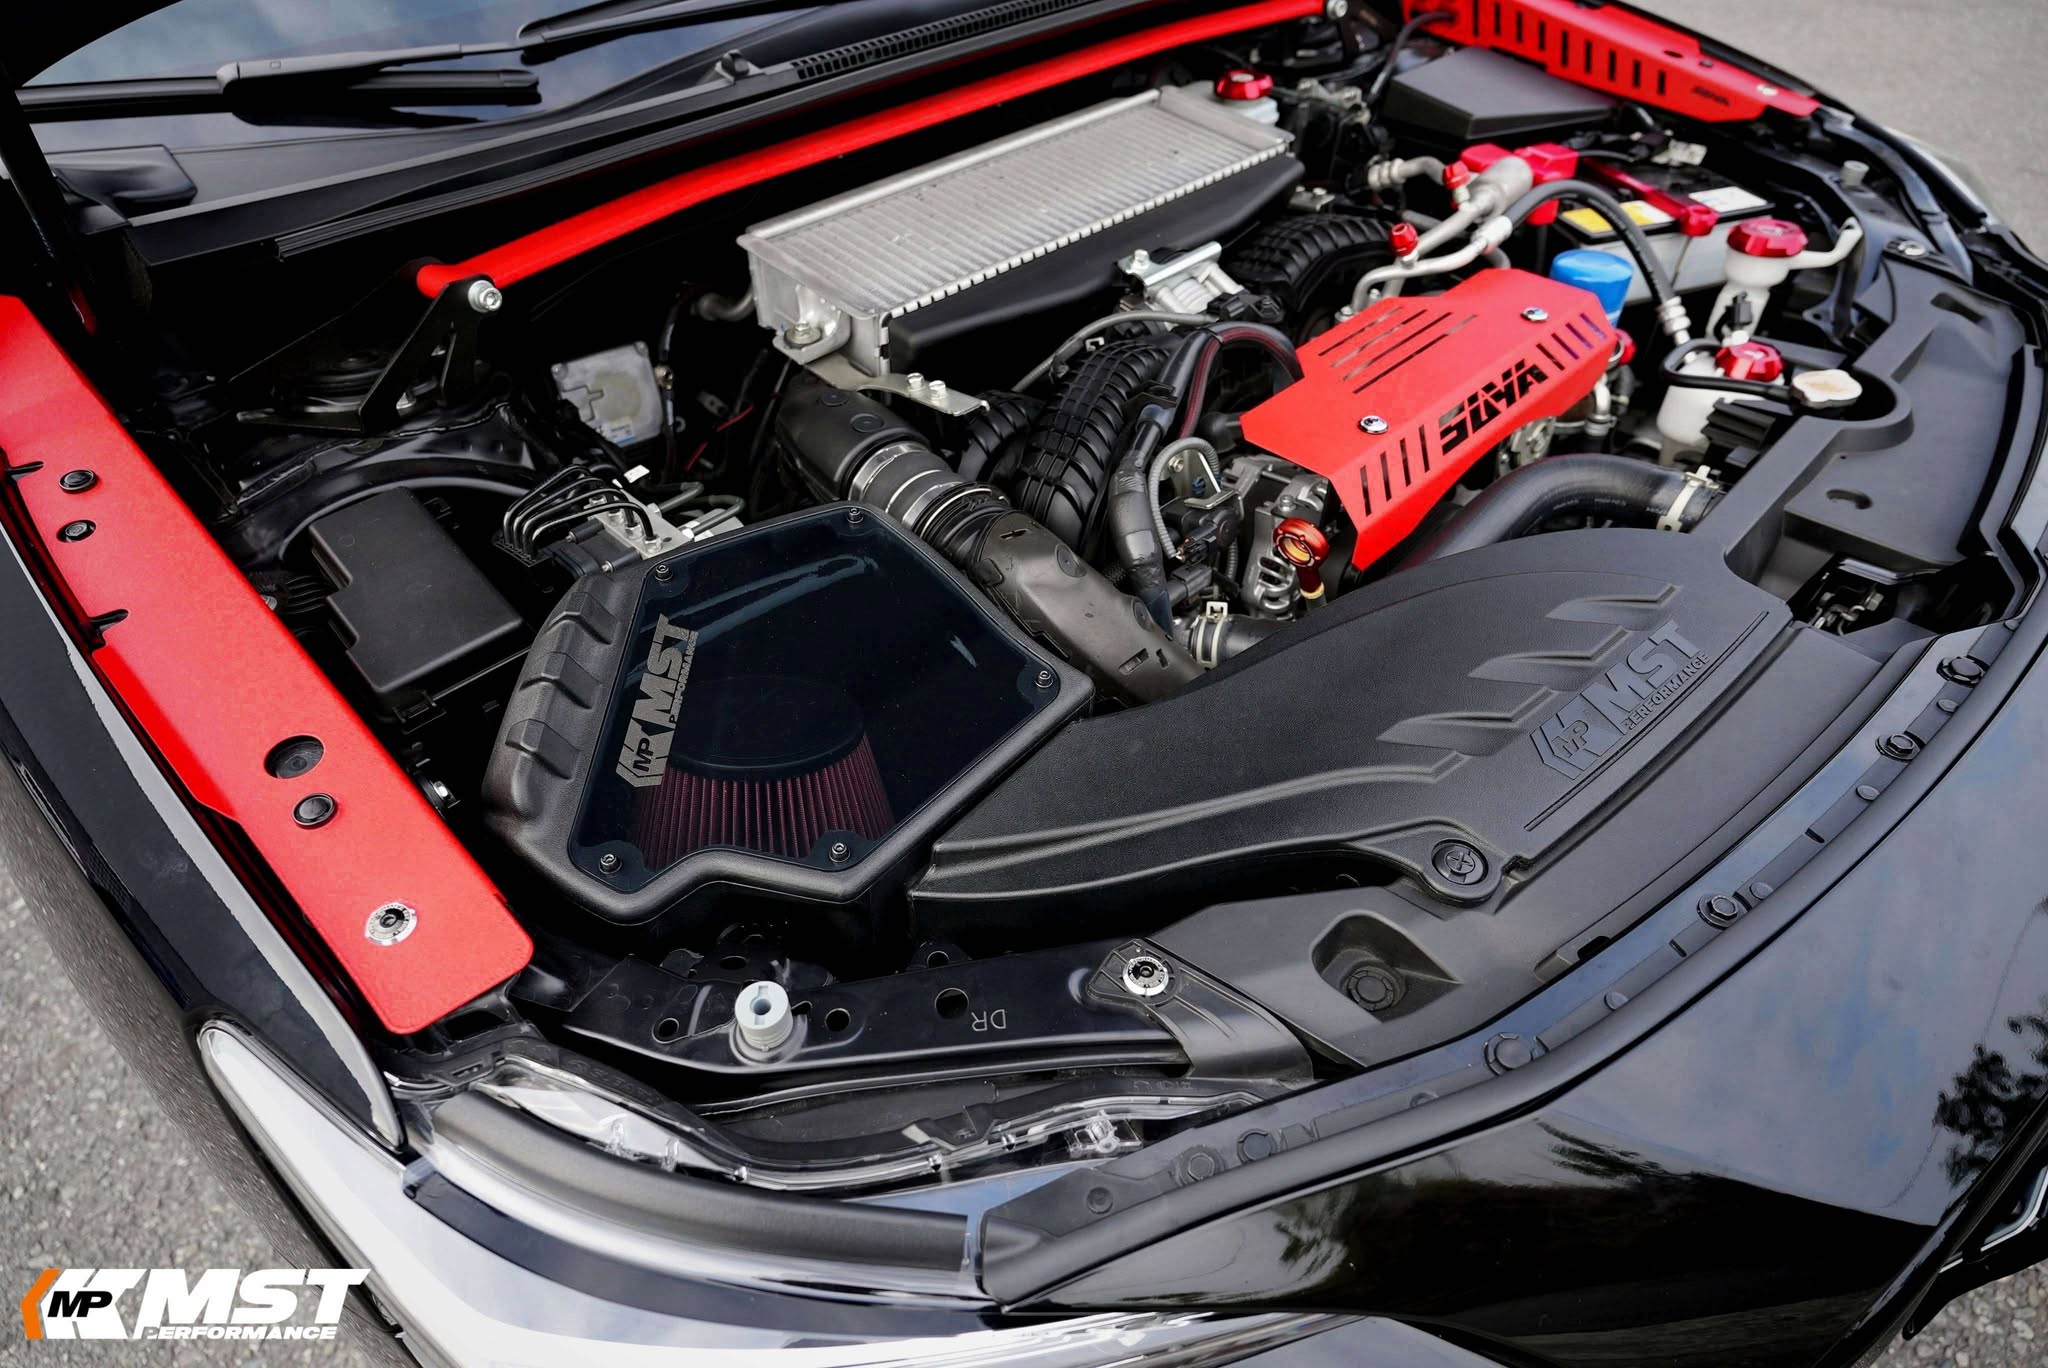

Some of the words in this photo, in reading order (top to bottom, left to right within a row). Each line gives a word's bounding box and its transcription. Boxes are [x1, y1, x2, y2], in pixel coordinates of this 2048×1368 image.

[631, 613, 690, 729] MST
[1551, 719, 1590, 759] MP
[1580, 619, 1702, 736] MST
[1619, 652, 1711, 731] PERFORMANCE
[633, 737, 654, 772] MP
[971, 1009, 1007, 1032] DR
